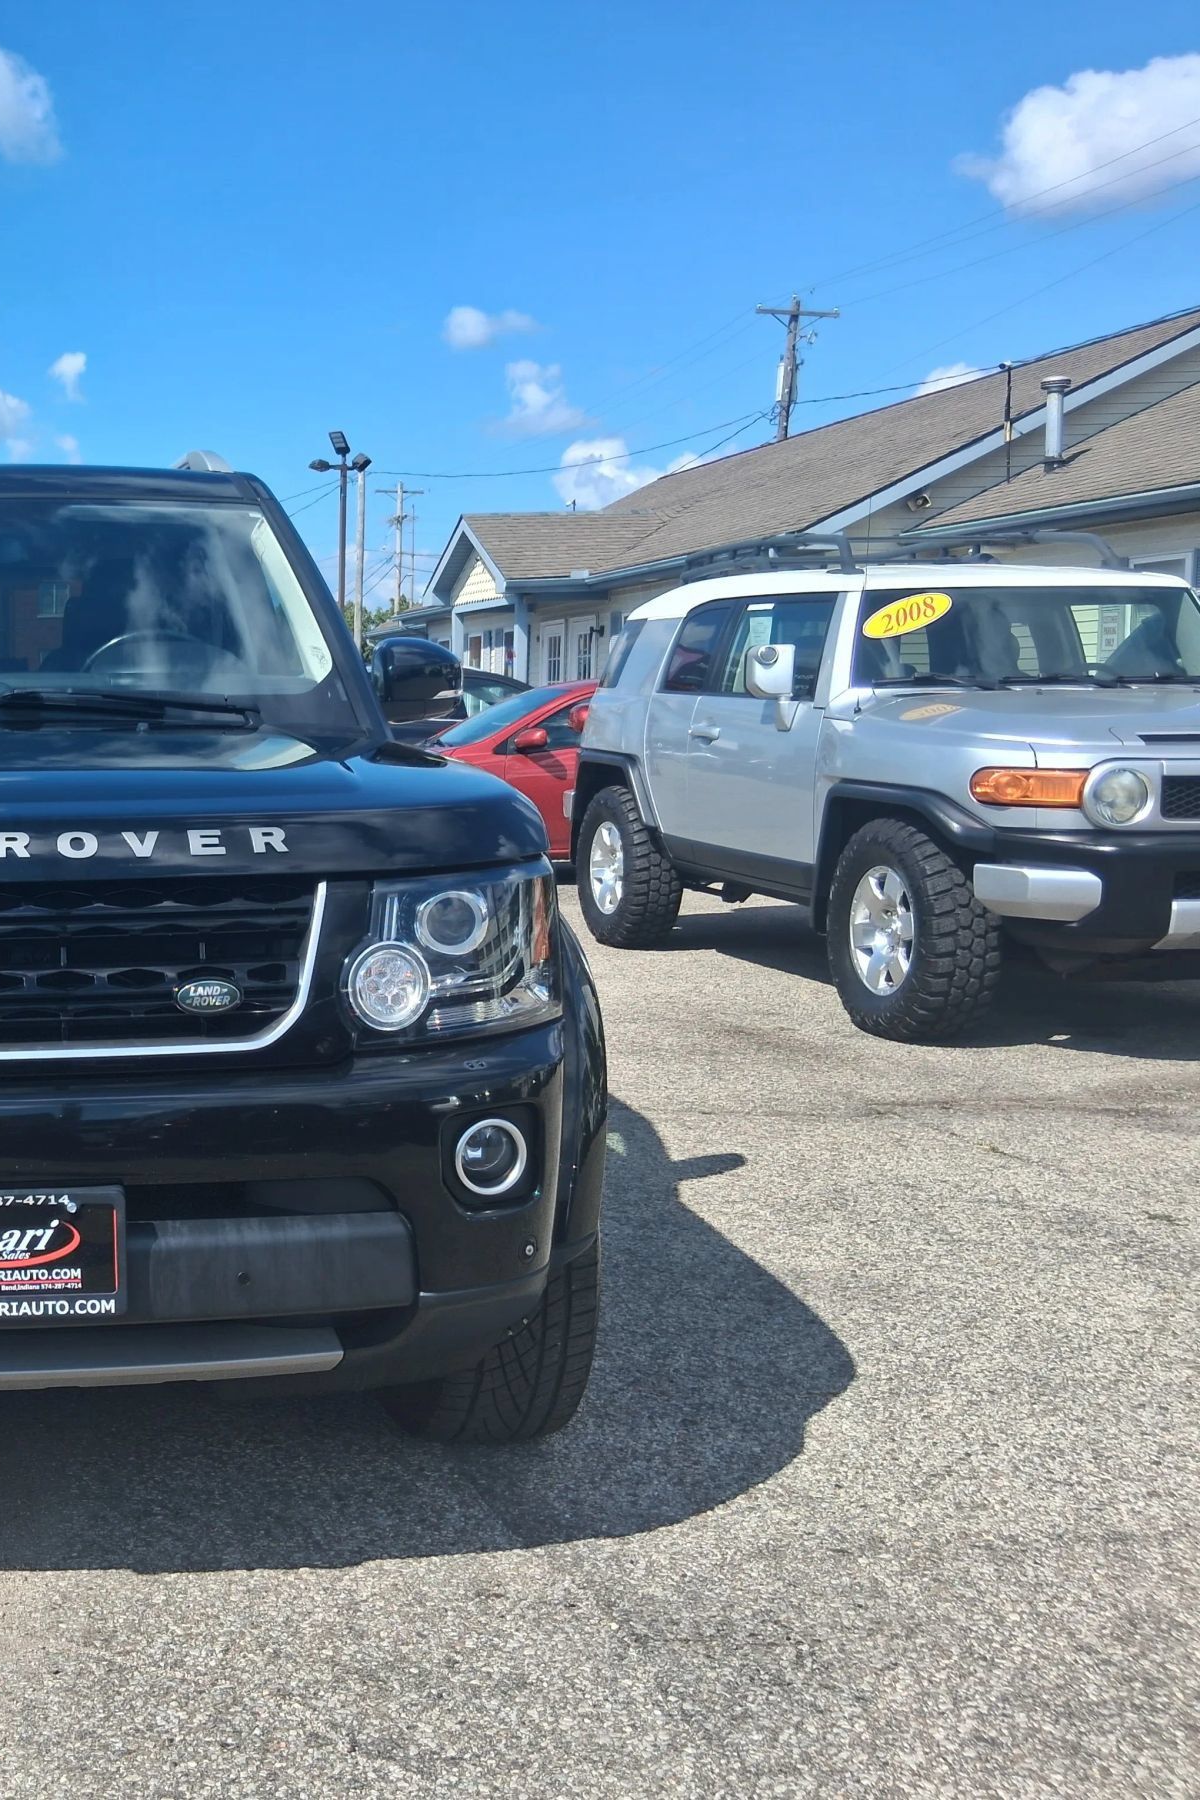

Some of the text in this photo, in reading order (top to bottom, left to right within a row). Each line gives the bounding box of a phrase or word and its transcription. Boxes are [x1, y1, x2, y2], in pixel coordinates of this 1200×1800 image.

[881, 596, 936, 634] 2008
[189, 986, 220, 996] LAND
[192, 996, 231, 1007] ROVER
[0, 1250, 31, 1262] Sales
